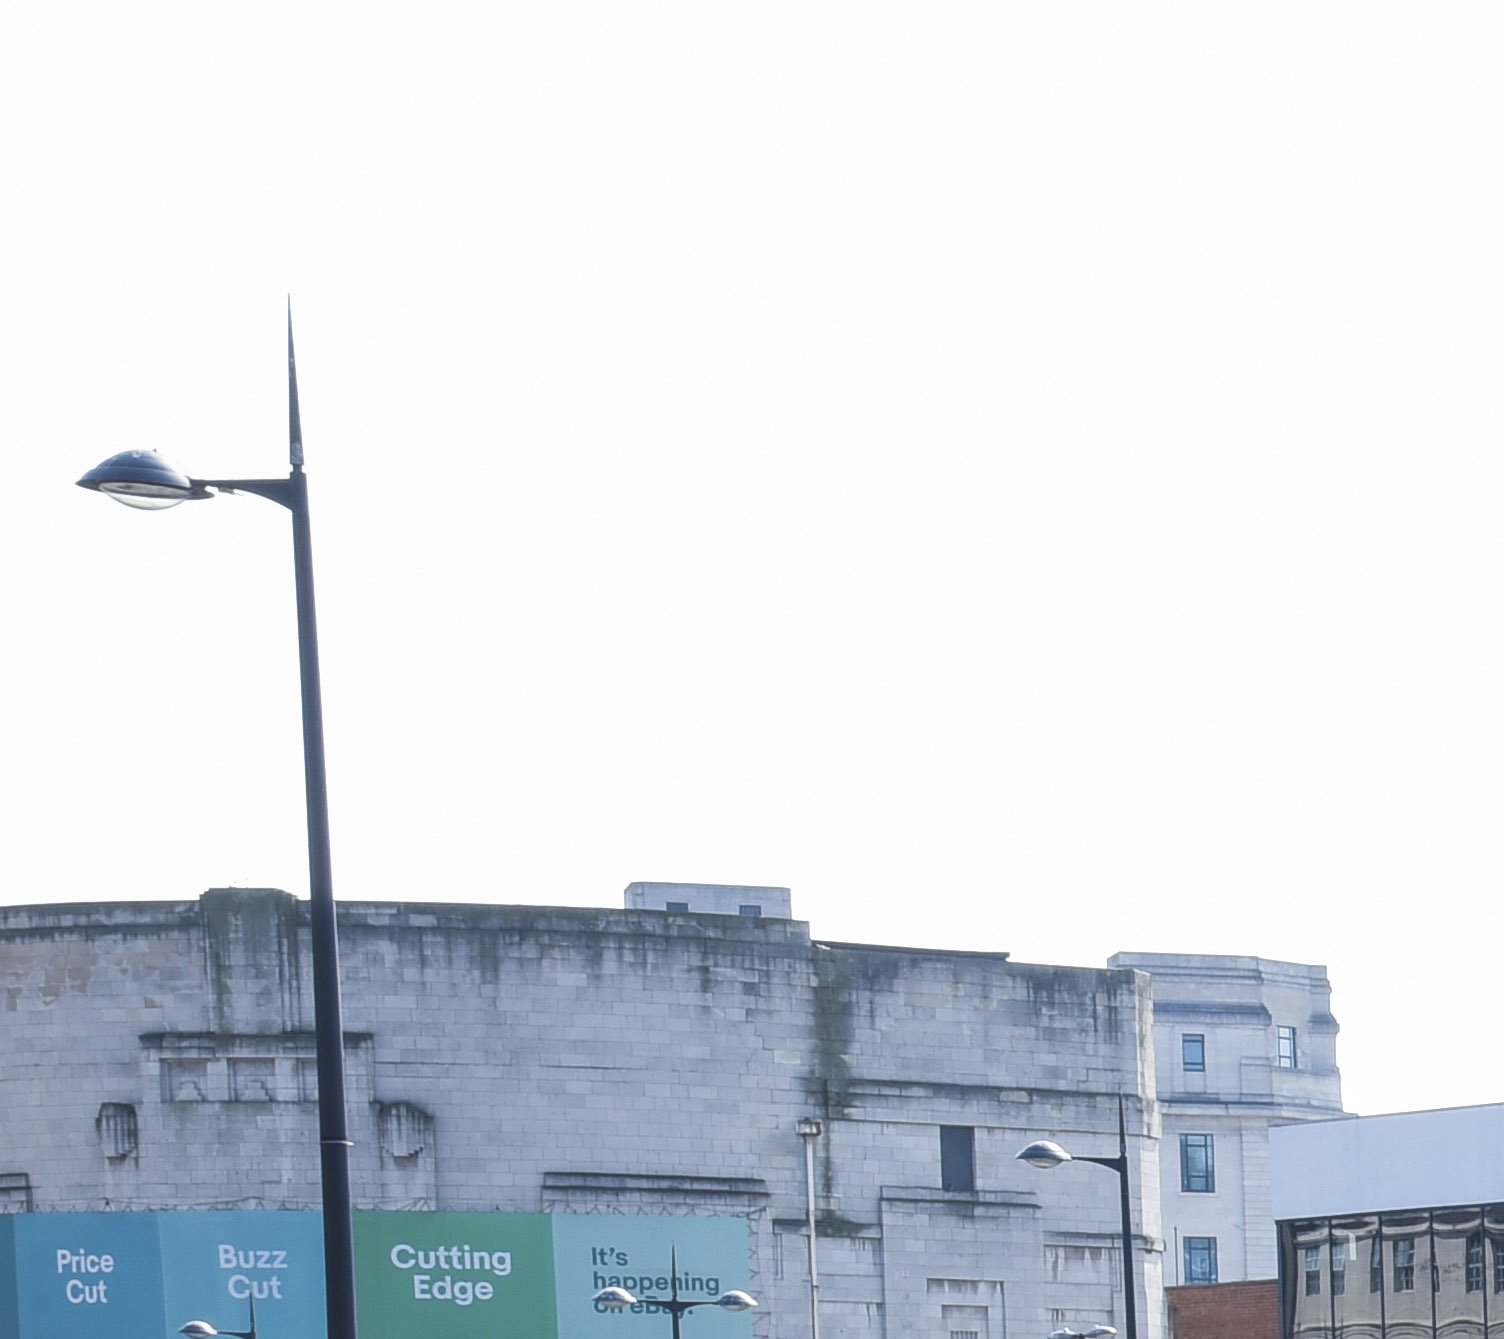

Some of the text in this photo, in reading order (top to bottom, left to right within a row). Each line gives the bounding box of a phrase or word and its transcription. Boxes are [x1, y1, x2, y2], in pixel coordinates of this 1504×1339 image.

[57, 1249, 115, 1274] Price
[218, 1244, 288, 1269] Buzz
[390, 1244, 512, 1276] Cutting
[591, 1247, 629, 1267] It's
[65, 1279, 109, 1304] Cut
[228, 1274, 282, 1300] Cut
[413, 1275, 494, 1306] Edge
[593, 1271, 720, 1297] happening
